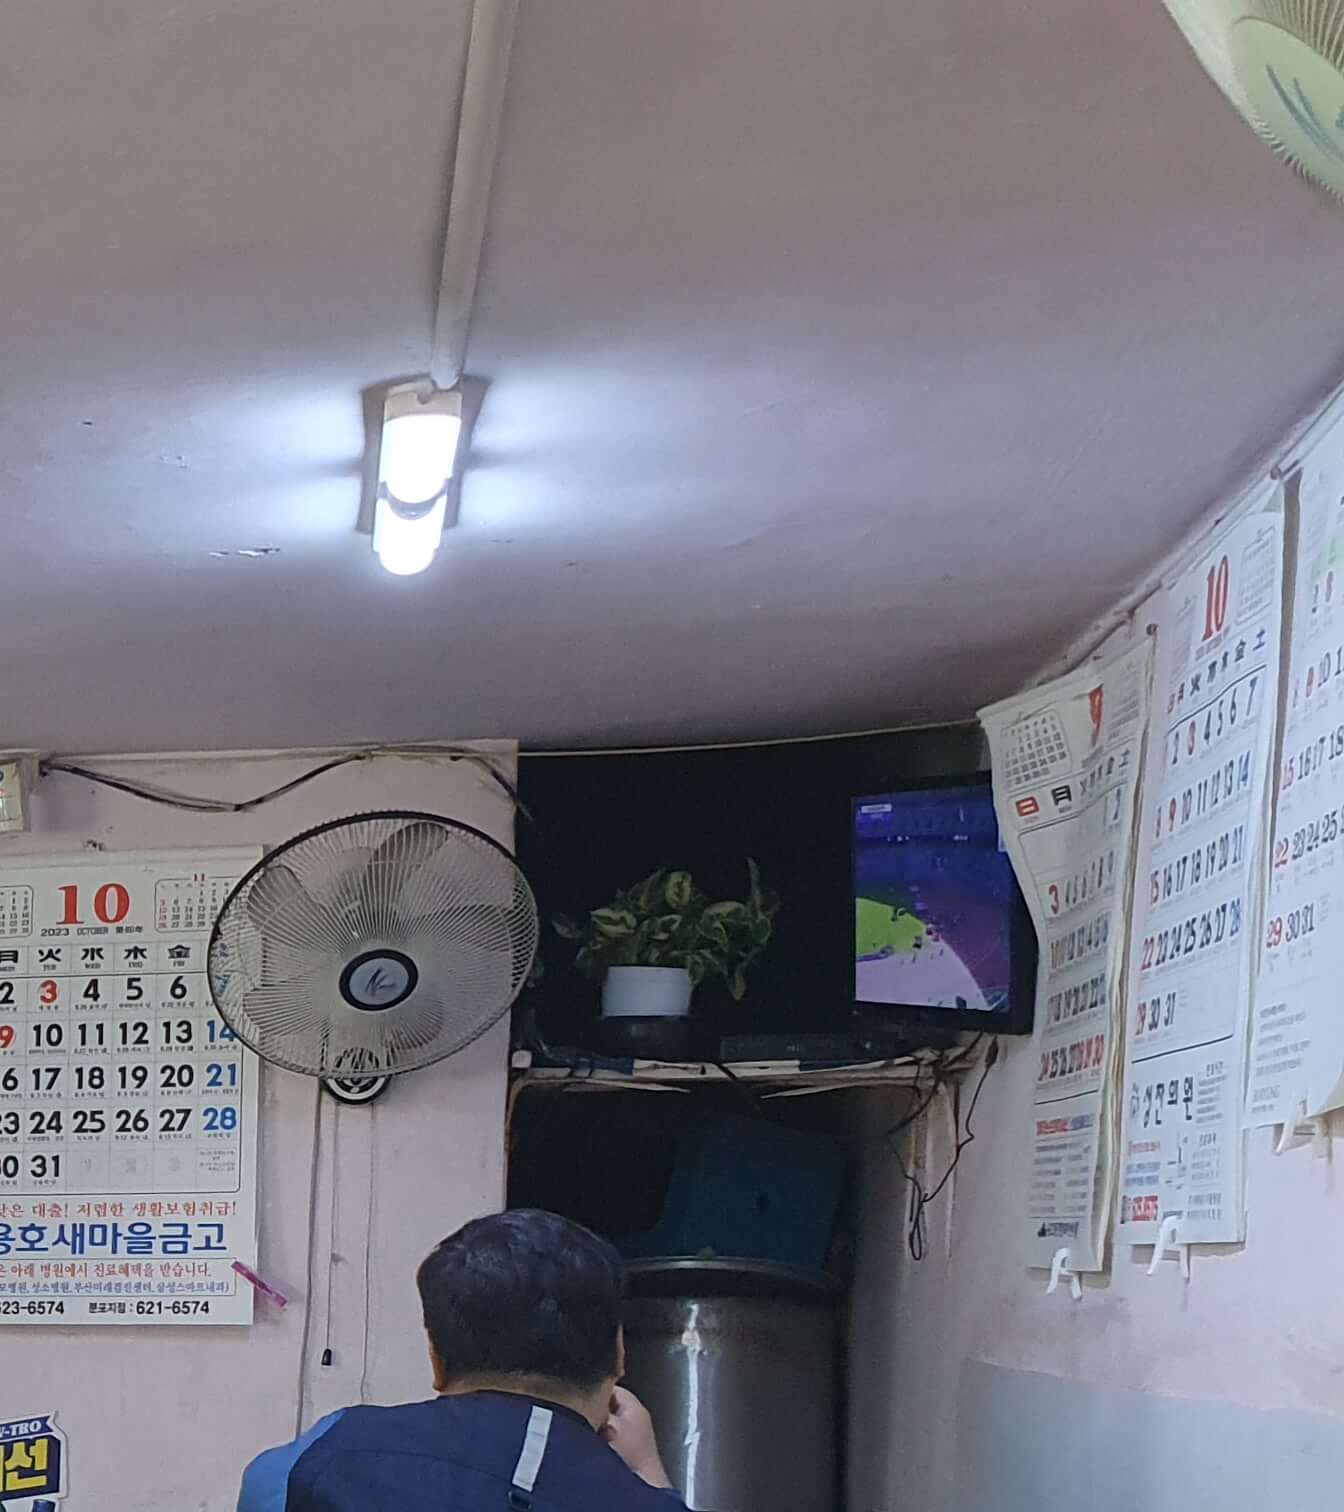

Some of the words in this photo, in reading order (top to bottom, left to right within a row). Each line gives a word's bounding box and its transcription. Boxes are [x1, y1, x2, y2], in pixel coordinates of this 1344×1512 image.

[1201, 555, 1229, 643] 10
[1229, 687, 1238, 726] 6
[1245, 677, 1258, 717] 7
[1297, 746, 1311, 780] 16
[1310, 735, 1325, 773] 17
[1181, 788, 1192, 825] 10
[1273, 837, 1289, 869] 22
[1291, 827, 1306, 862] 23
[1305, 820, 1321, 854] 24
[1321, 810, 1338, 846] 25
[1150, 870, 1160, 905] 15
[1162, 863, 1173, 899] 16
[1175, 855, 1188, 893] 17
[1190, 848, 1201, 887] 18
[1205, 841, 1217, 879] 19
[1218, 832, 1230, 872] 20
[1231, 824, 1243, 865] 21
[56, 883, 131, 926] 10
[1048, 884, 1059, 914] 3
[40, 928, 70, 938] 2023
[1140, 938, 1155, 971] 22
[1155, 930, 1169, 967] 23
[1169, 923, 1183, 961] 24
[1183, 916, 1198, 956] 25
[1199, 910, 1212, 950] 26
[1214, 902, 1228, 944] 27
[1229, 898, 1241, 937] 28
[1265, 915, 1283, 949] 29
[1285, 913, 1301, 944] 30
[1300, 903, 1315, 934] 31
[37, 948, 62, 963] 火
[80, 947, 105, 961] 水
[123, 946, 148, 960] 木
[167, 944, 191, 959] 金
[40, 980, 58, 1004] 3
[83, 978, 100, 1002] 4
[126, 977, 143, 1001] 5
[170, 976, 187, 1000] 6
[1134, 1001, 1147, 1036] 29
[1148, 997, 1161, 1032] 30
[1163, 991, 1177, 1027] 31
[33, 1023, 63, 1047] 10
[77, 1022, 104, 1046] 11
[119, 1021, 149, 1045] 12
[163, 1019, 193, 1043] 13
[207, 1019, 238, 1043] 14
[32, 1067, 62, 1090] 17
[75, 1066, 105, 1089] 18
[118, 1065, 148, 1089] 19
[160, 1064, 194, 1088] 20
[206, 1063, 237, 1087] 21
[29, 1110, 62, 1134] 24
[72, 1110, 106, 1133] 25
[115, 1109, 149, 1133] 26
[159, 1108, 192, 1132] 27
[202, 1106, 237, 1130] 28
[30, 1154, 60, 1178] 31
[32, 1202, 69, 1218] 대출!
[77, 1201, 124, 1217] 저렴한
[10, 1263, 34, 1278] 아래
[40, 1263, 88, 1278] 병원에서
[160, 1262, 212, 1277] 받습니다.
[136, 1301, 210, 1315] 621-6574
